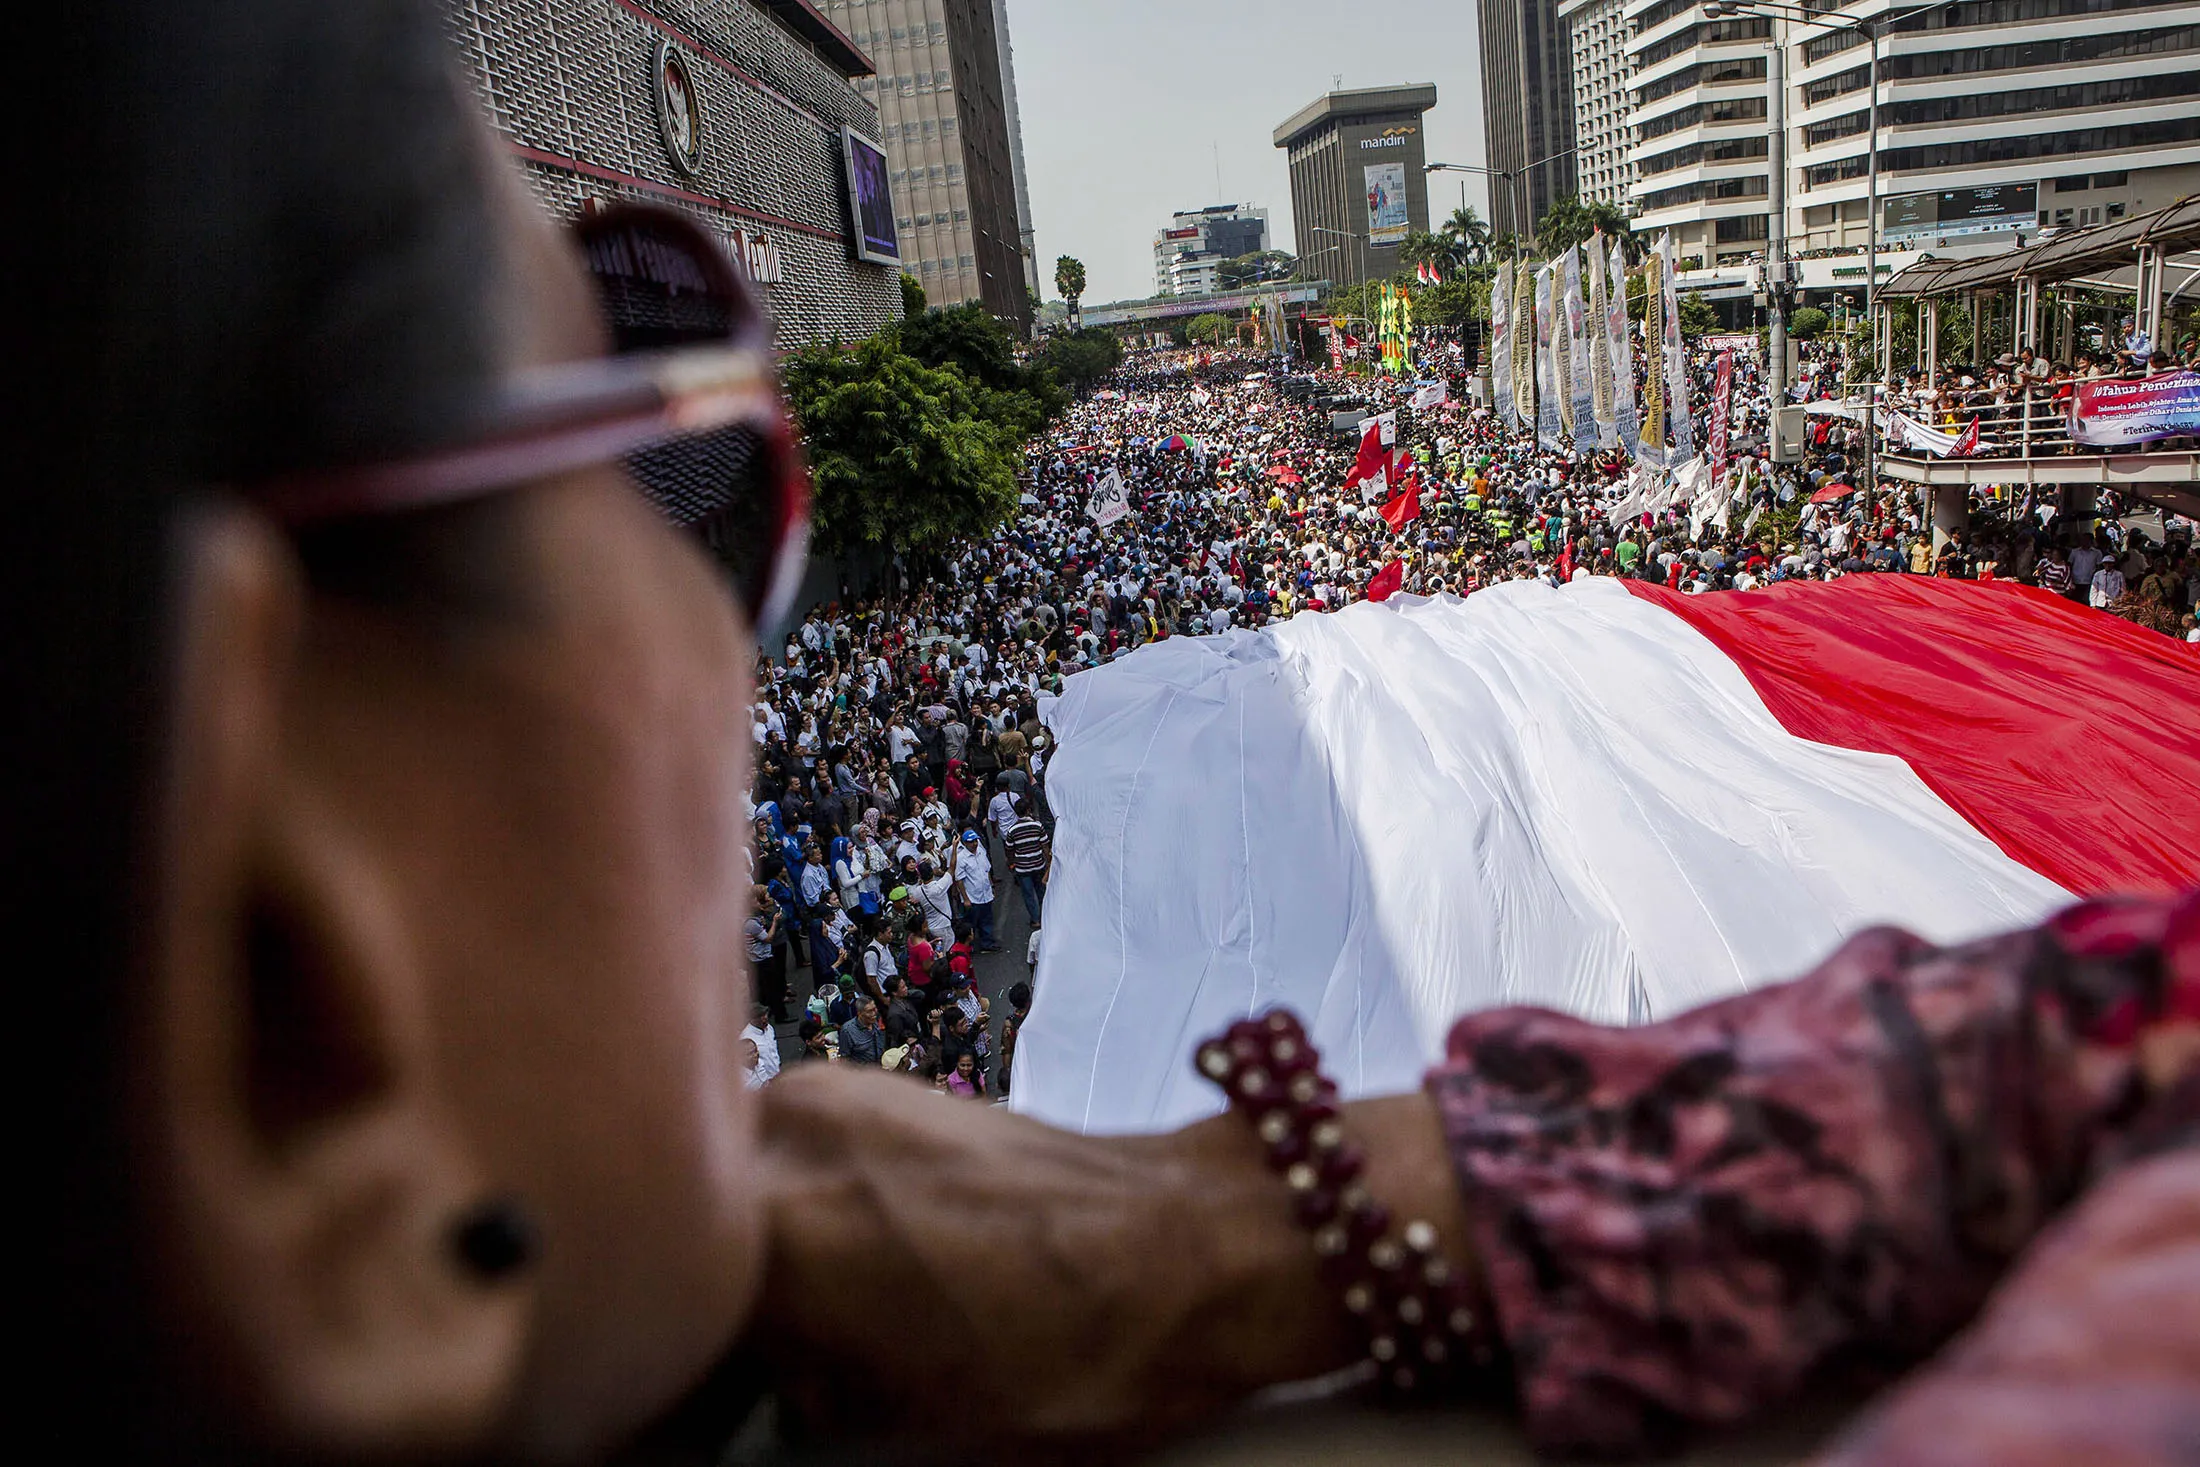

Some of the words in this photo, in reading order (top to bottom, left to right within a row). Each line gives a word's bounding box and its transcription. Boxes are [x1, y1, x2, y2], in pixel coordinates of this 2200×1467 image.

[1360, 134, 1406, 149] mandiri
[740, 230, 783, 284] Pemilu
[2103, 384, 2137, 396] Tahun
[2097, 403, 2127, 412] Indonesia
